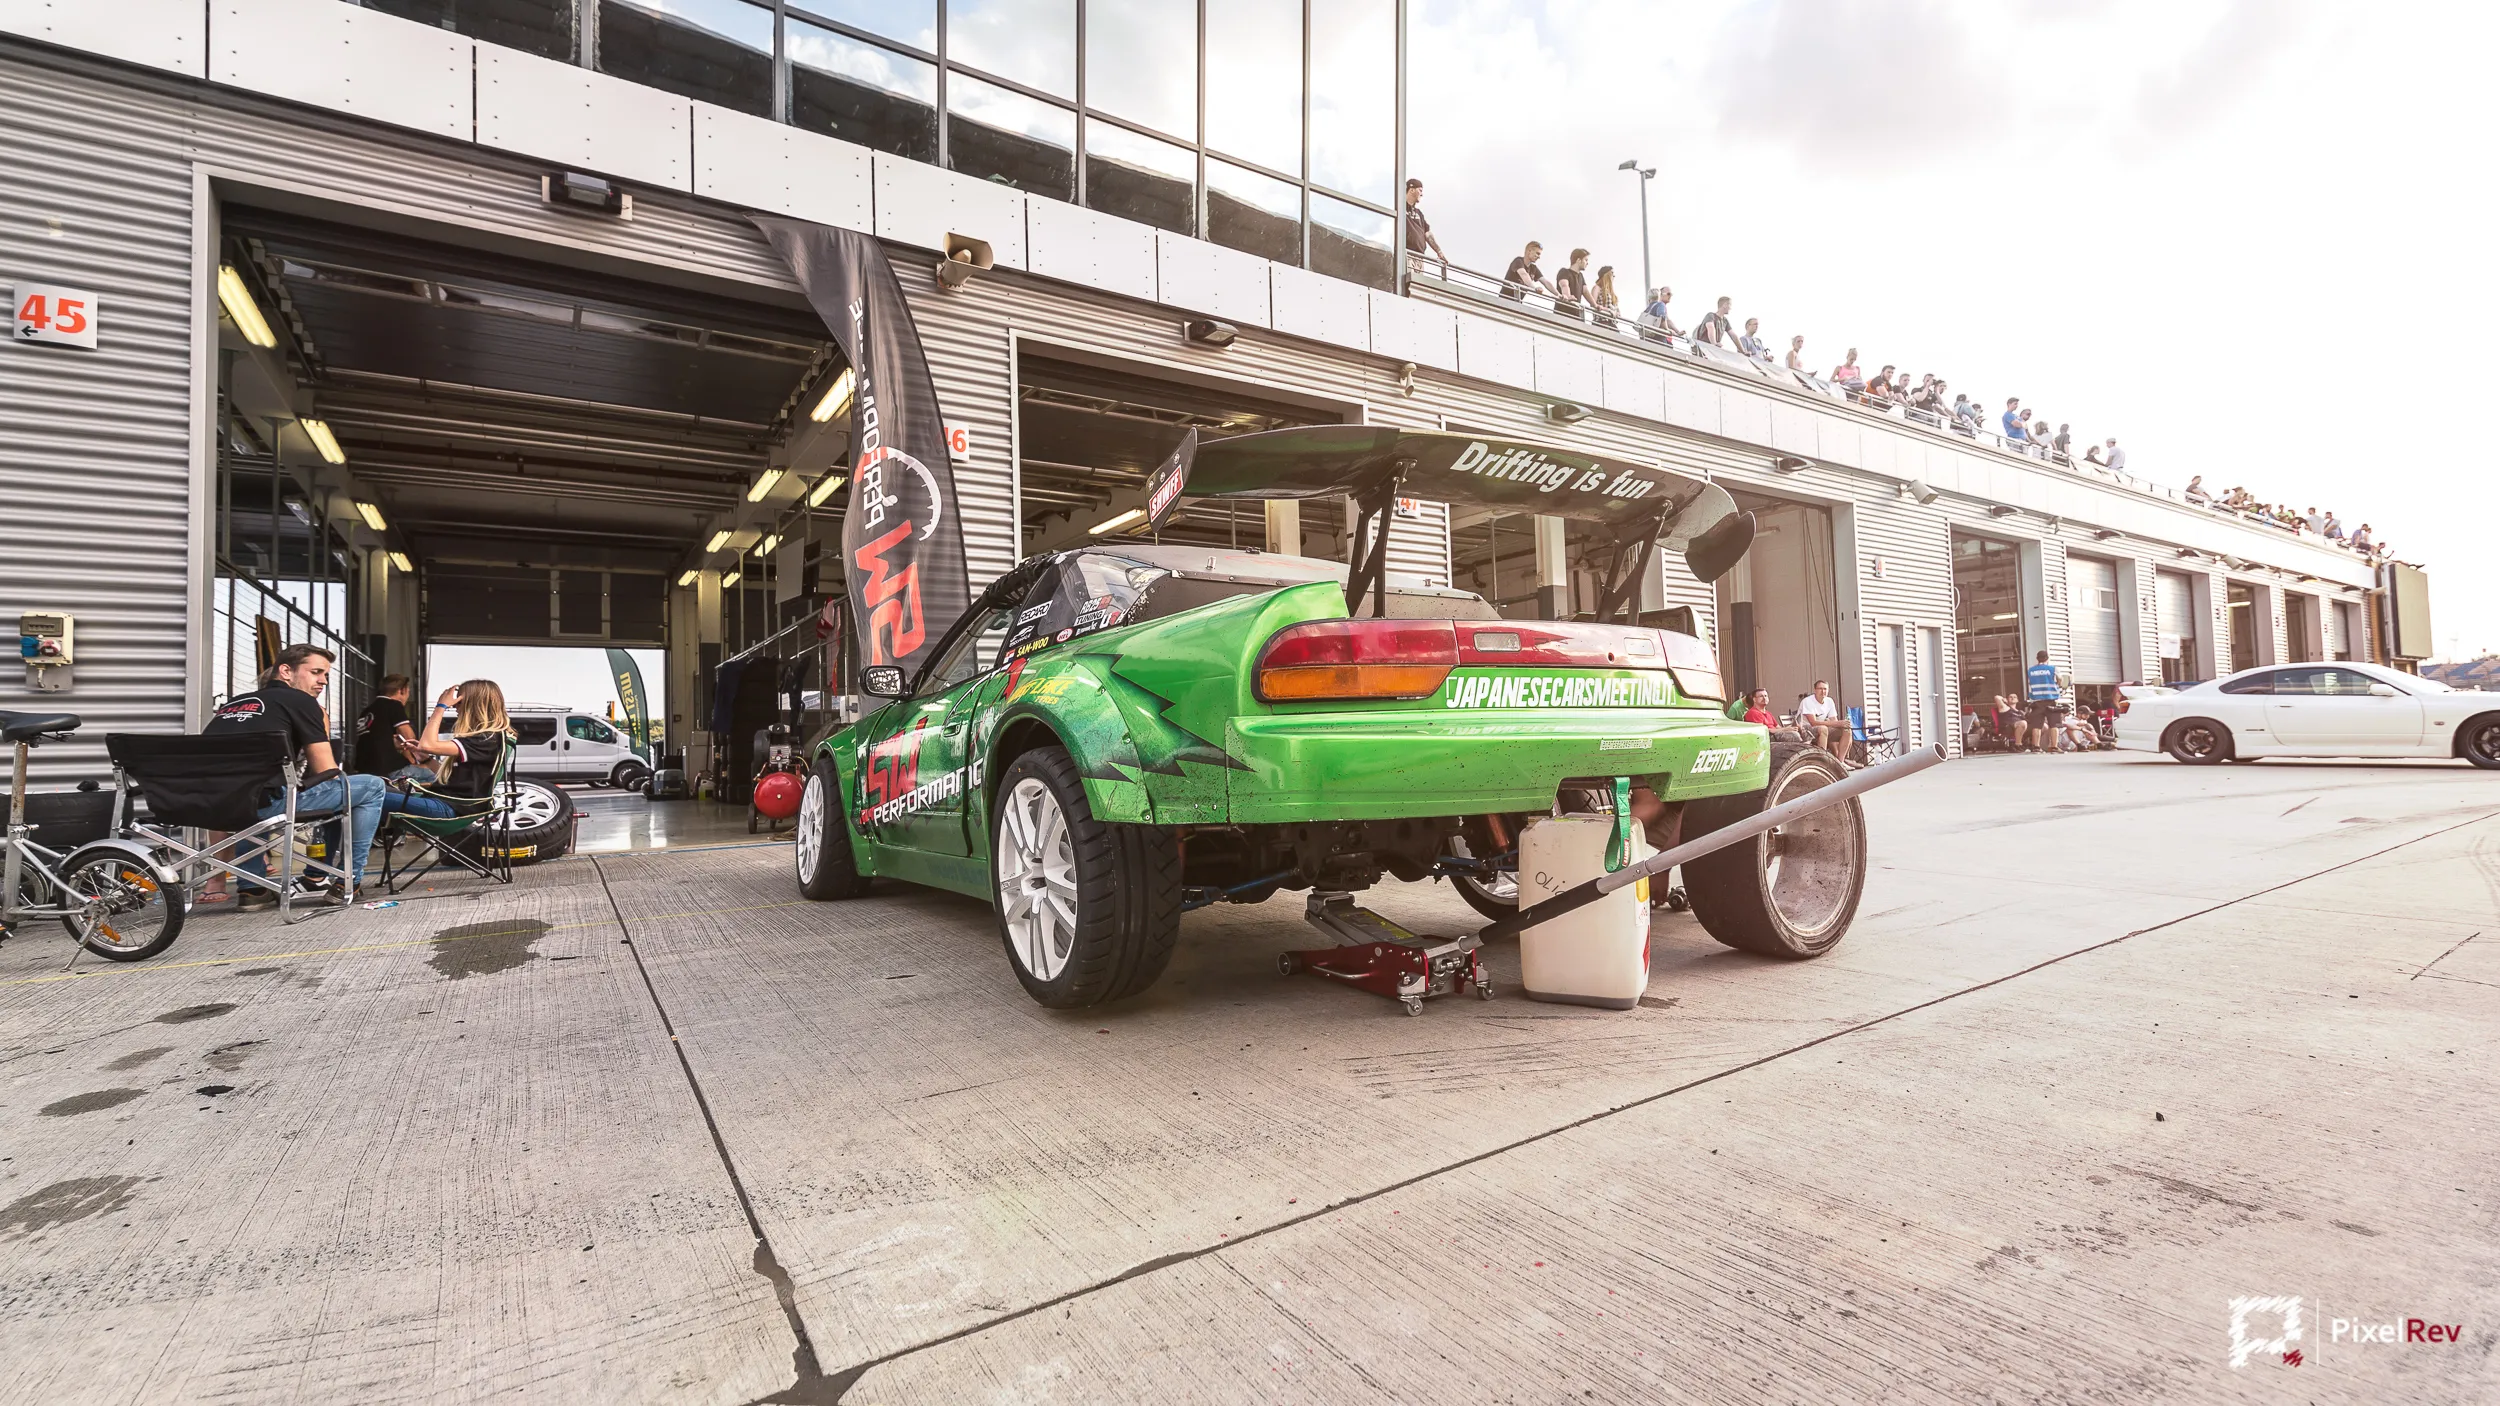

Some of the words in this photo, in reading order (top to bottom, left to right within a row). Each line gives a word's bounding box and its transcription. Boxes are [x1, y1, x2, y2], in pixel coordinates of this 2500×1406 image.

[19, 294, 87, 334] 45
[1450, 441, 1576, 493] Drifting
[1570, 464, 1606, 491] is
[1602, 469, 1655, 499] fun
[1017, 636, 1049, 657] SAM-WOO
[866, 715, 929, 812] SW
[873, 758, 984, 826] PERFORMANC
